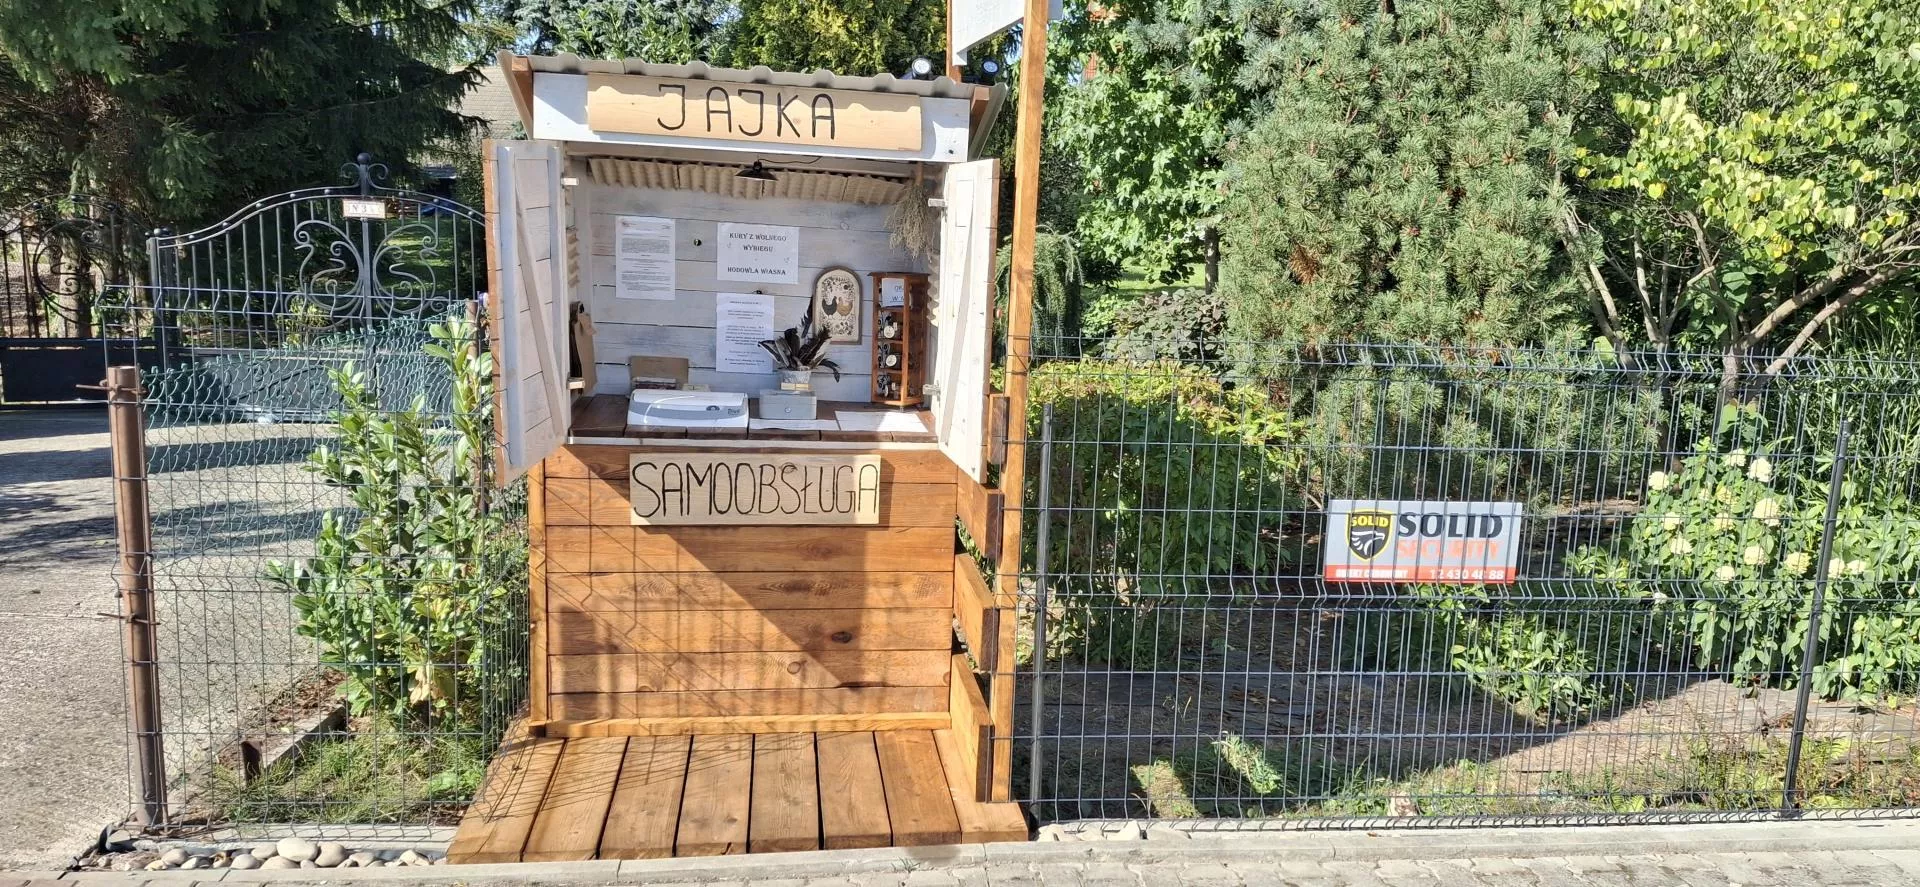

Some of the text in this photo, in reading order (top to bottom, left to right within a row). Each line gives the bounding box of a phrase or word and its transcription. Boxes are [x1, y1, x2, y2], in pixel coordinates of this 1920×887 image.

[657, 83, 836, 140] JAJKA
[729, 232, 748, 240] KURY
[755, 233, 787, 242] WOLNEGO
[743, 244, 774, 252] WYBIEGU
[727, 266, 759, 274] HODOWLA
[631, 461, 880, 518] SAMOOBSŁUGA
[1351, 515, 1389, 527] SOLID
[1398, 511, 1503, 539] SOLID
[1489, 570, 1505, 580] 88
